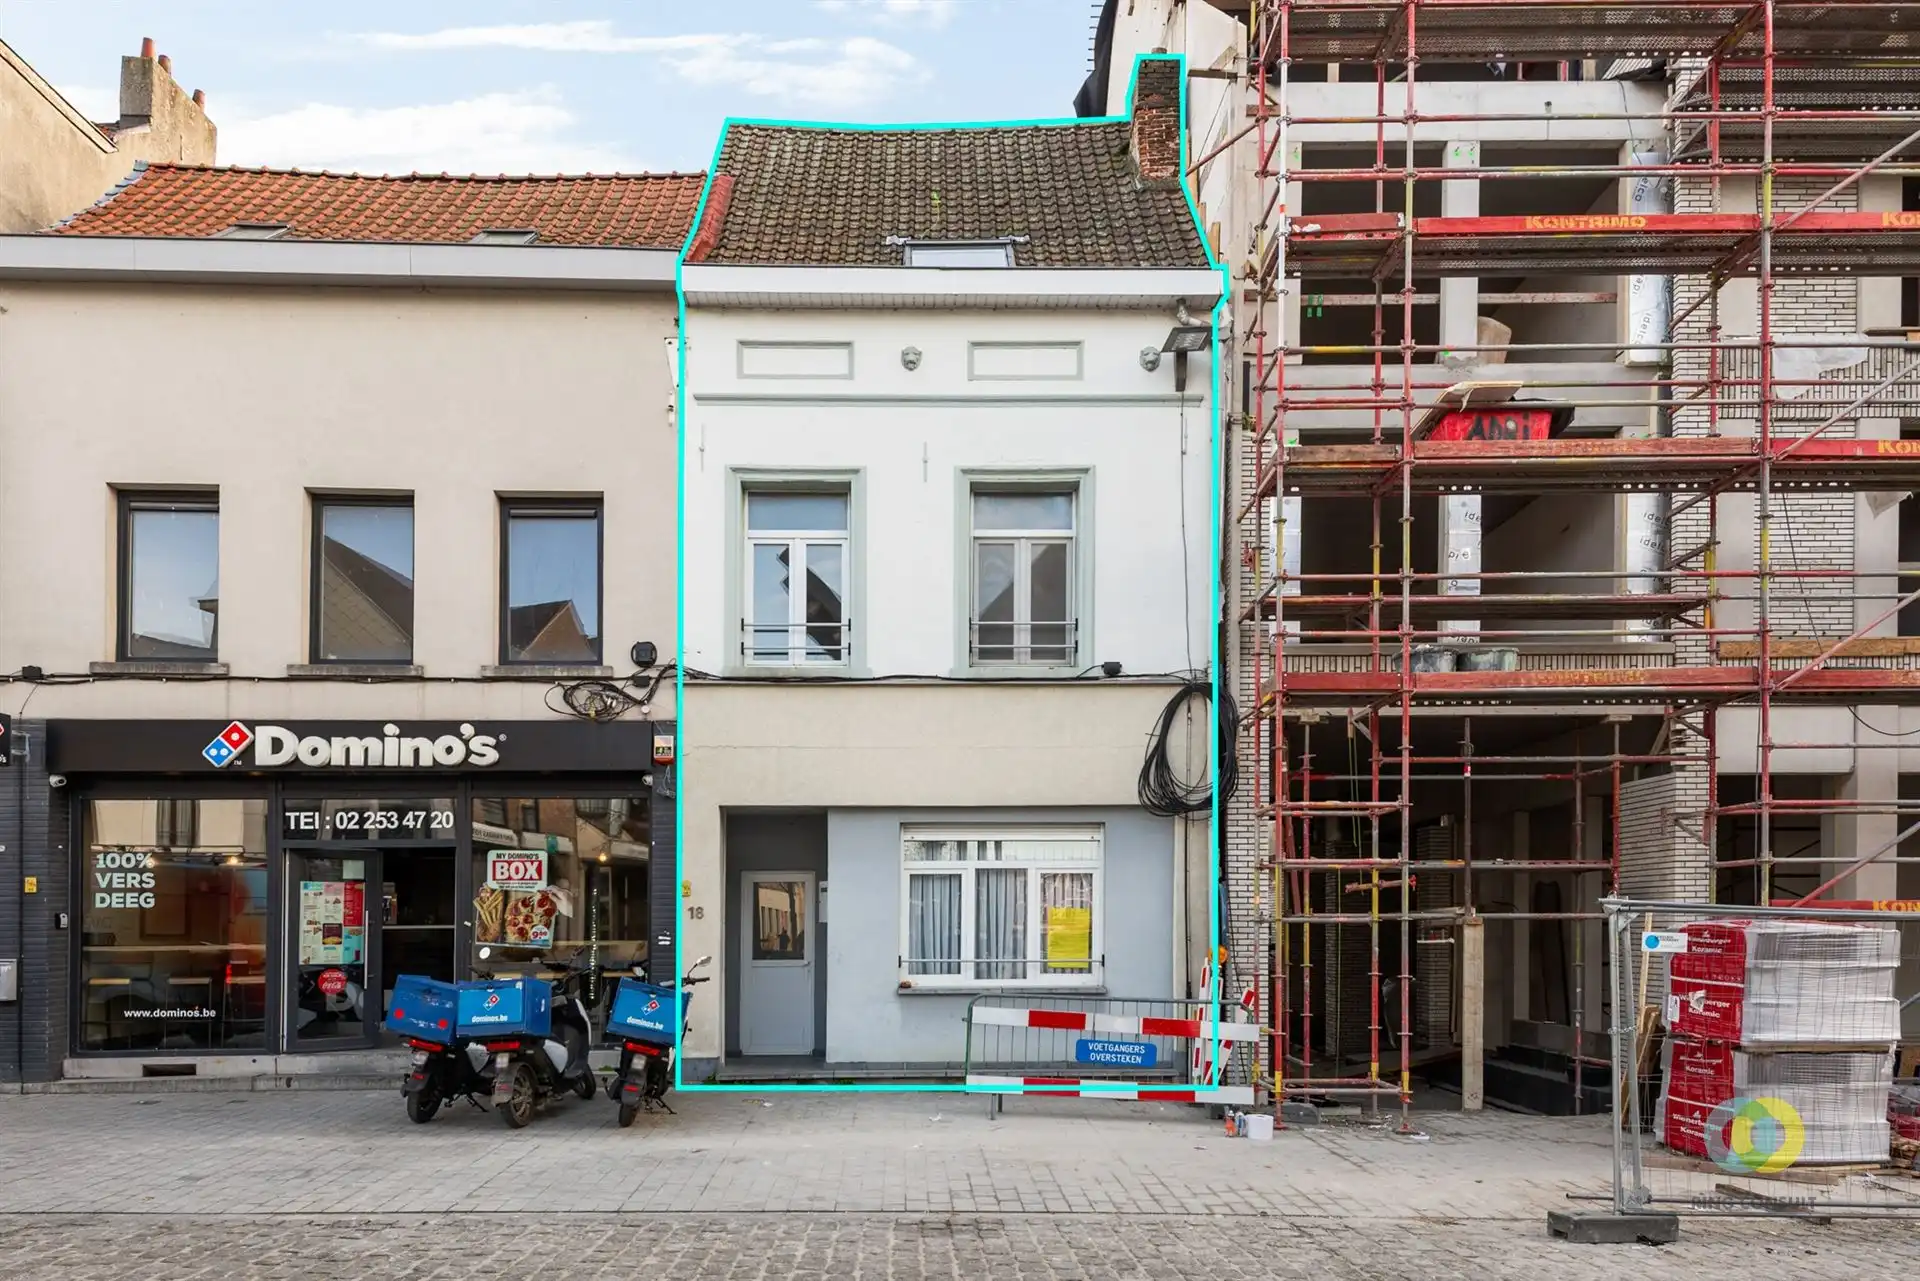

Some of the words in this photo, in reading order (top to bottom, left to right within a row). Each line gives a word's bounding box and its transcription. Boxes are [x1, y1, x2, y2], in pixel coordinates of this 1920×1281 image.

[1525, 215, 1647, 229] KONTRIMO
[1881, 211, 1920, 226] KO
[254, 723, 500, 768] Domino's
[335, 811, 360, 829] 02
[363, 811, 399, 829] 253
[402, 811, 427, 829] 47
[430, 810, 455, 829] 20
[95, 852, 155, 869] 100%
[496, 852, 507, 860] MY
[508, 852, 540, 861] DOMINO'S
[494, 861, 540, 880] BOX
[95, 872, 156, 889] VERS
[95, 892, 156, 909] DEEG
[687, 906, 705, 920] 18
[123, 1008, 217, 1018] www.dominos.be
[1088, 1042, 1146, 1054] VOETGANGERS
[1090, 1052, 1142, 1064] OVERSTEKEN
